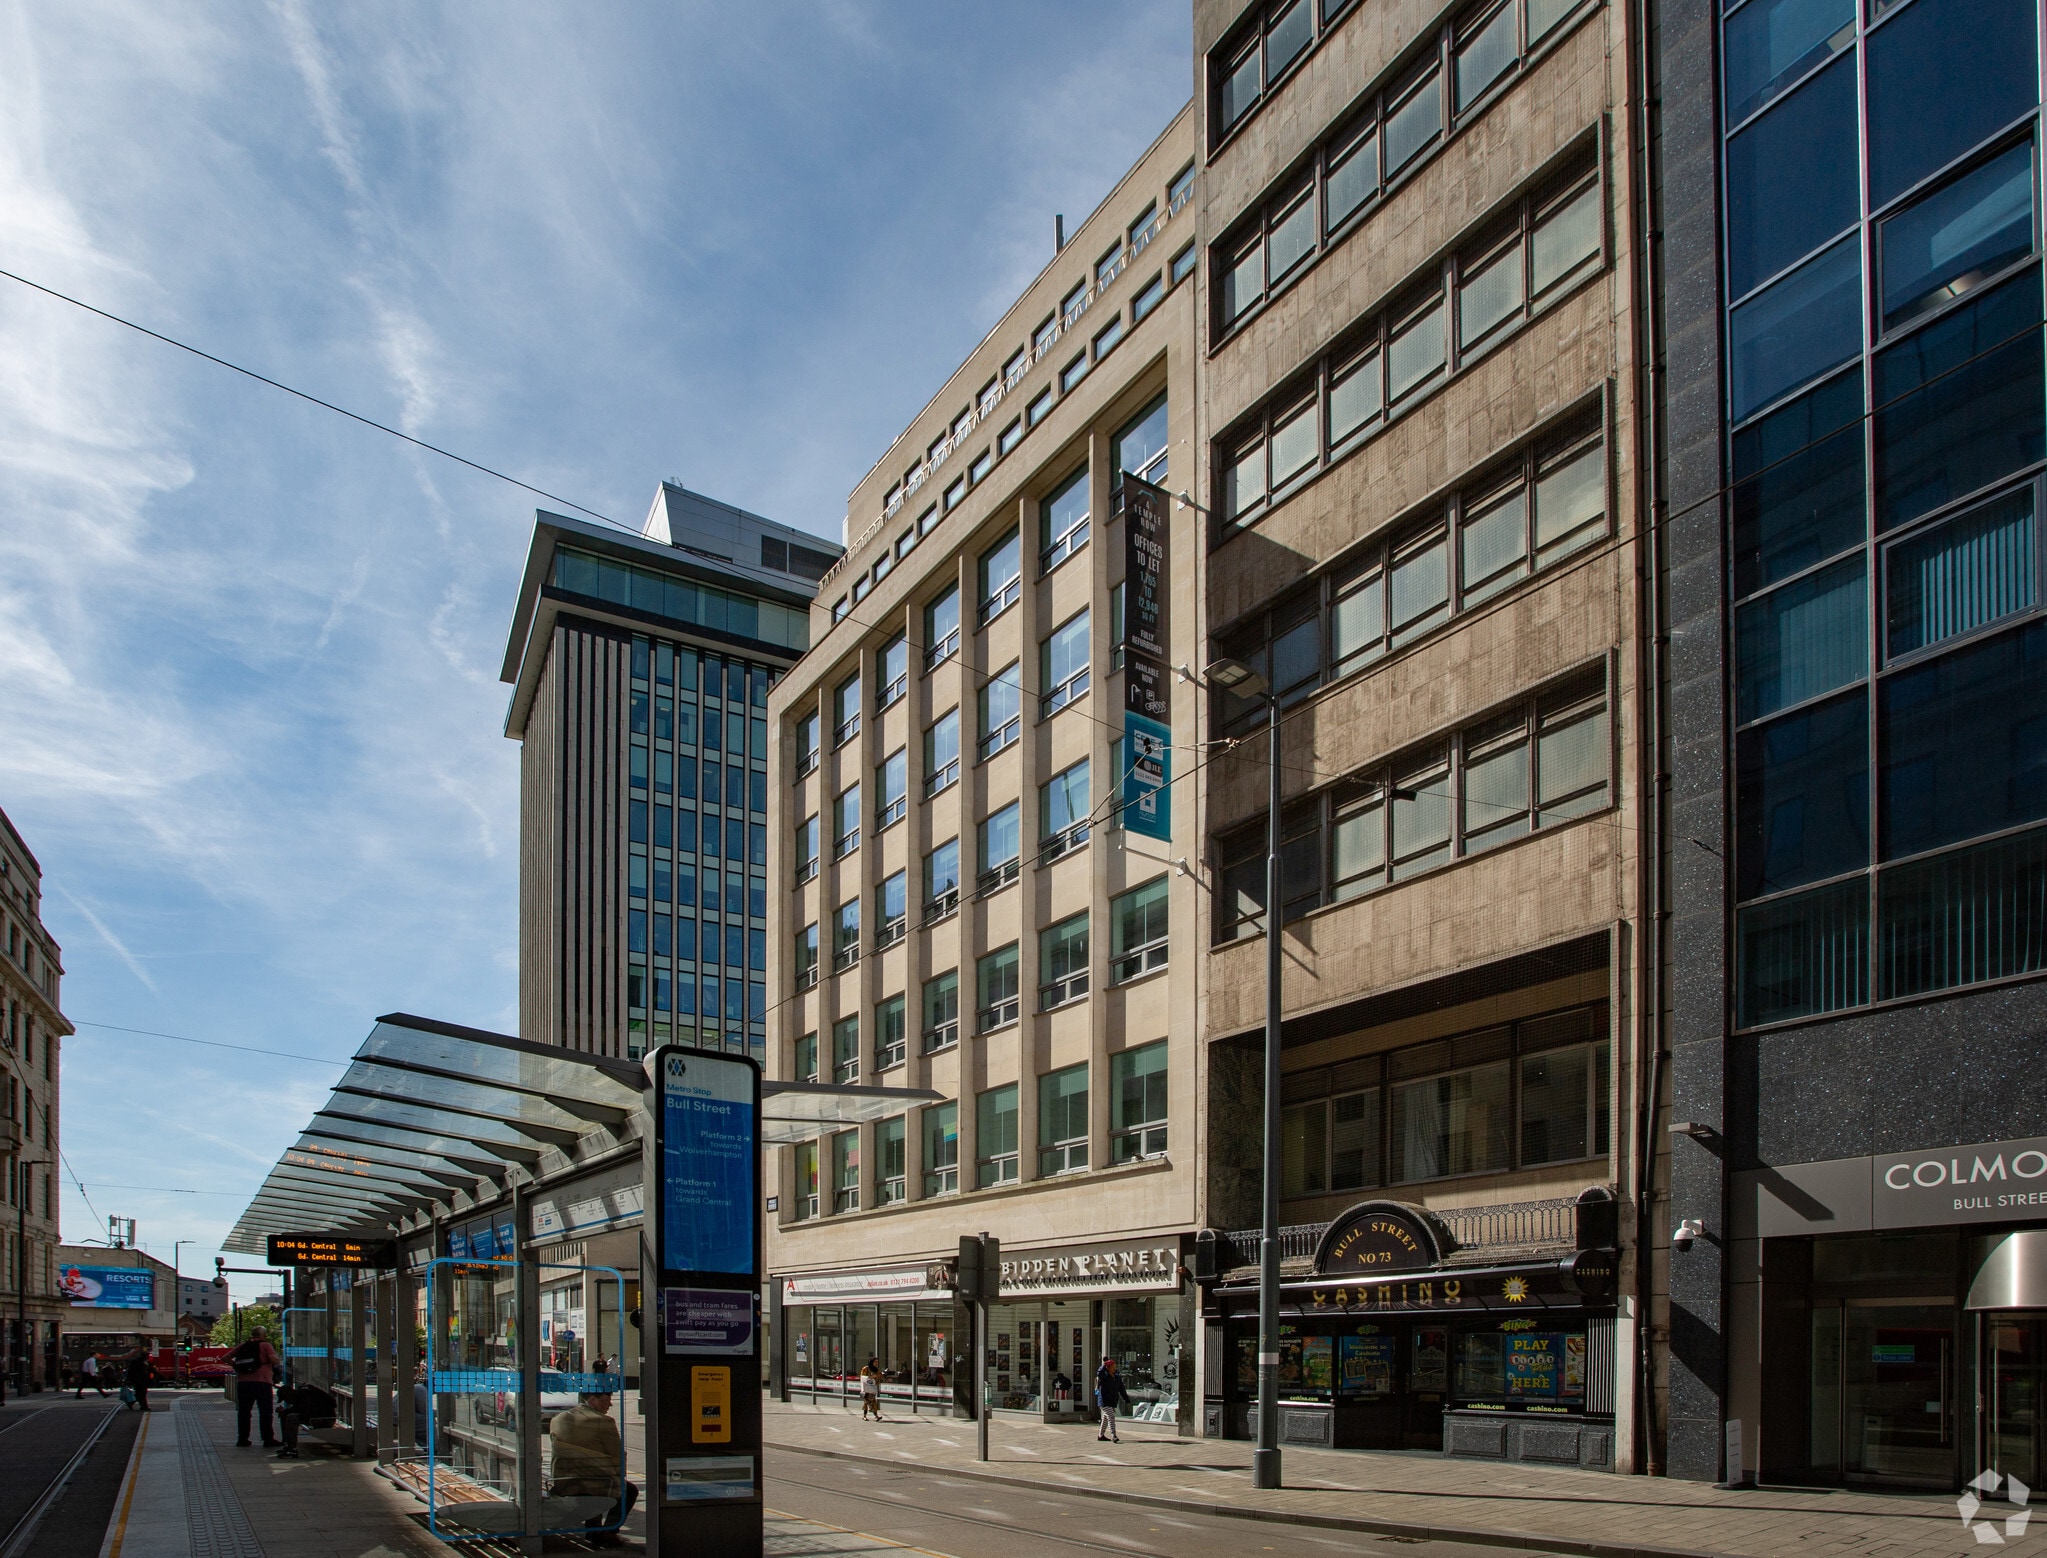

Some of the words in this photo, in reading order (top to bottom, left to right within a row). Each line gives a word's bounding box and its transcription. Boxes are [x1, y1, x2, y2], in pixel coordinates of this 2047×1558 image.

[1134, 504, 1161, 526] TEMPLE
[1140, 517, 1156, 532] ROW
[1134, 533, 1163, 559] OFFICES
[1136, 550, 1146, 566] TO
[1148, 556, 1160, 573] LET
[1144, 585, 1152, 599] TO
[1140, 629, 1154, 642] FULLY
[1131, 635, 1163, 655] REFURBISHED
[1135, 662, 1159, 678] AVAILABLE
[1141, 673, 1154, 684] NOW
[666, 1083, 691, 1093] Metro
[693, 1086, 712, 1097] Stop
[666, 1097, 690, 1110] Bull
[693, 1100, 731, 1115] Street
[701, 1130, 736, 1140] Platform
[679, 1145, 742, 1159] Wolverhampton
[710, 1141, 742, 1150] towards
[675, 1177, 711, 1187] Platform
[675, 1187, 708, 1196] towards
[675, 1195, 701, 1204] Grand
[702, 1197, 732, 1206] Central
[1953, 1196, 1992, 1210] BULL
[311, 1242, 336, 1250] Central
[1334, 1228, 1363, 1258] BULL
[1371, 1222, 1418, 1252] STREET
[311, 1253, 337, 1261] Central
[343, 1254, 361, 1262] 14min
[1001, 1256, 1069, 1275] BIDDEN
[1082, 1249, 1164, 1270] PLANET
[1358, 1253, 1376, 1264] NO
[1378, 1252, 1391, 1263] 73
[1040, 1273, 1110, 1284] ENTERTAINMENT
[1112, 1269, 1168, 1280] MEGASTORE
[1576, 1268, 1610, 1276] CASHINO
[106, 1274, 152, 1284] RESORTS
[1313, 1280, 1461, 1303] CASHINO
[688, 1310, 716, 1318] cheaper
[1513, 1340, 1549, 1351] PLAY
[1512, 1378, 1550, 1388] HERE
[1467, 1403, 1506, 1411] cashino.com
[1526, 1405, 1568, 1413] cashino.com
